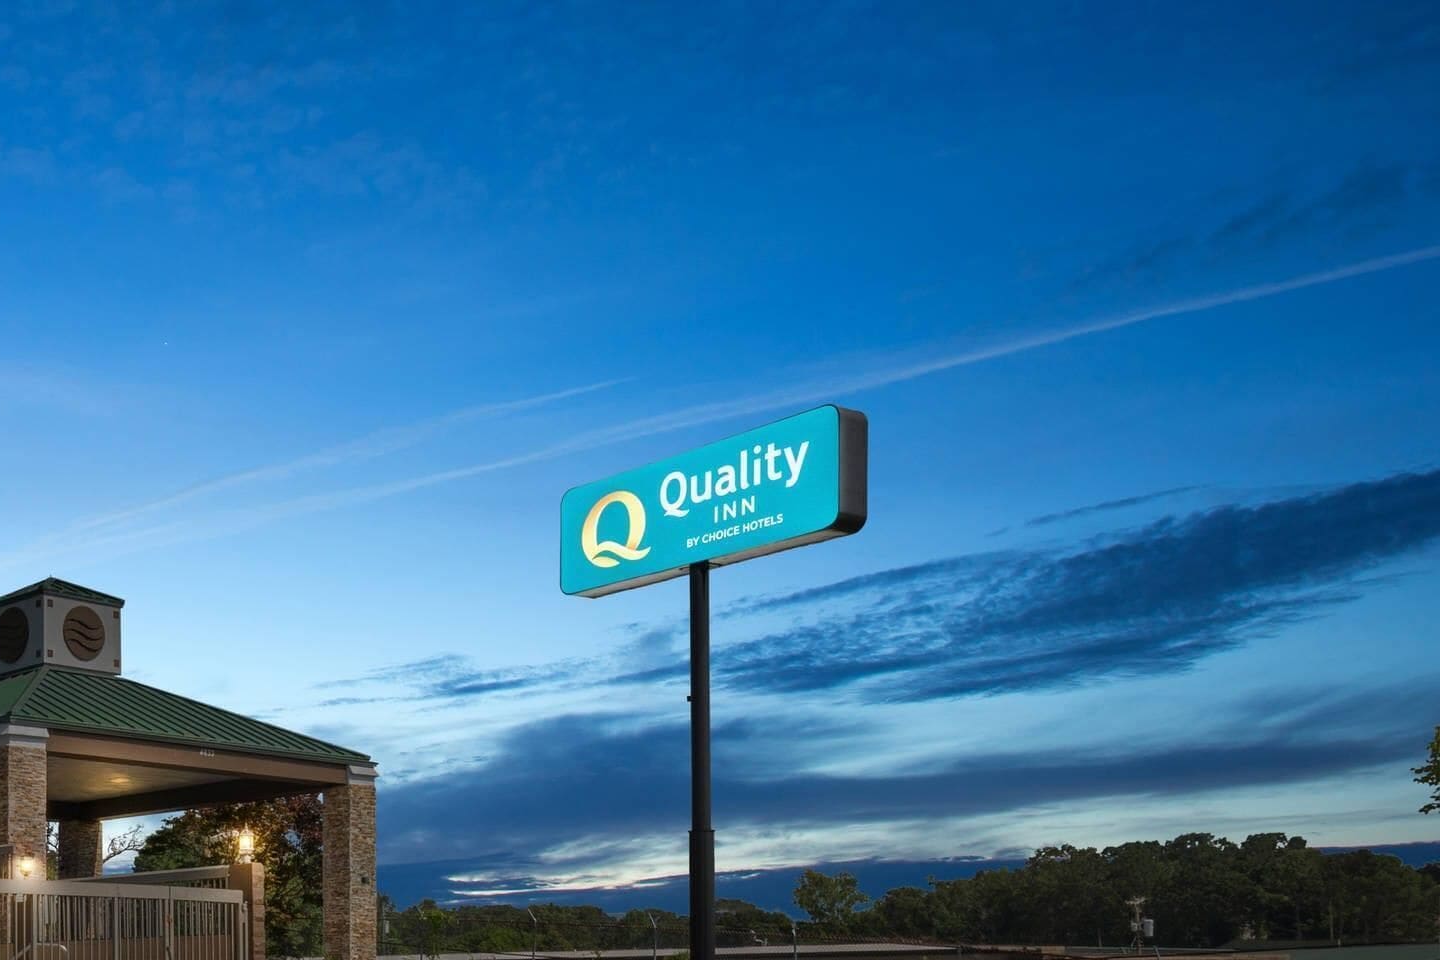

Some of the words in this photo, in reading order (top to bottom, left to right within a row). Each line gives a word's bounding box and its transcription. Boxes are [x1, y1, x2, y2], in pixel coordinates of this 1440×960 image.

[659, 440, 810, 518] Quality
[581, 490, 651, 568] Q
[686, 537, 700, 549] BY
[701, 526, 741, 544] CHOICE
[742, 513, 784, 533] HOTELS
[714, 496, 756, 523] INN
